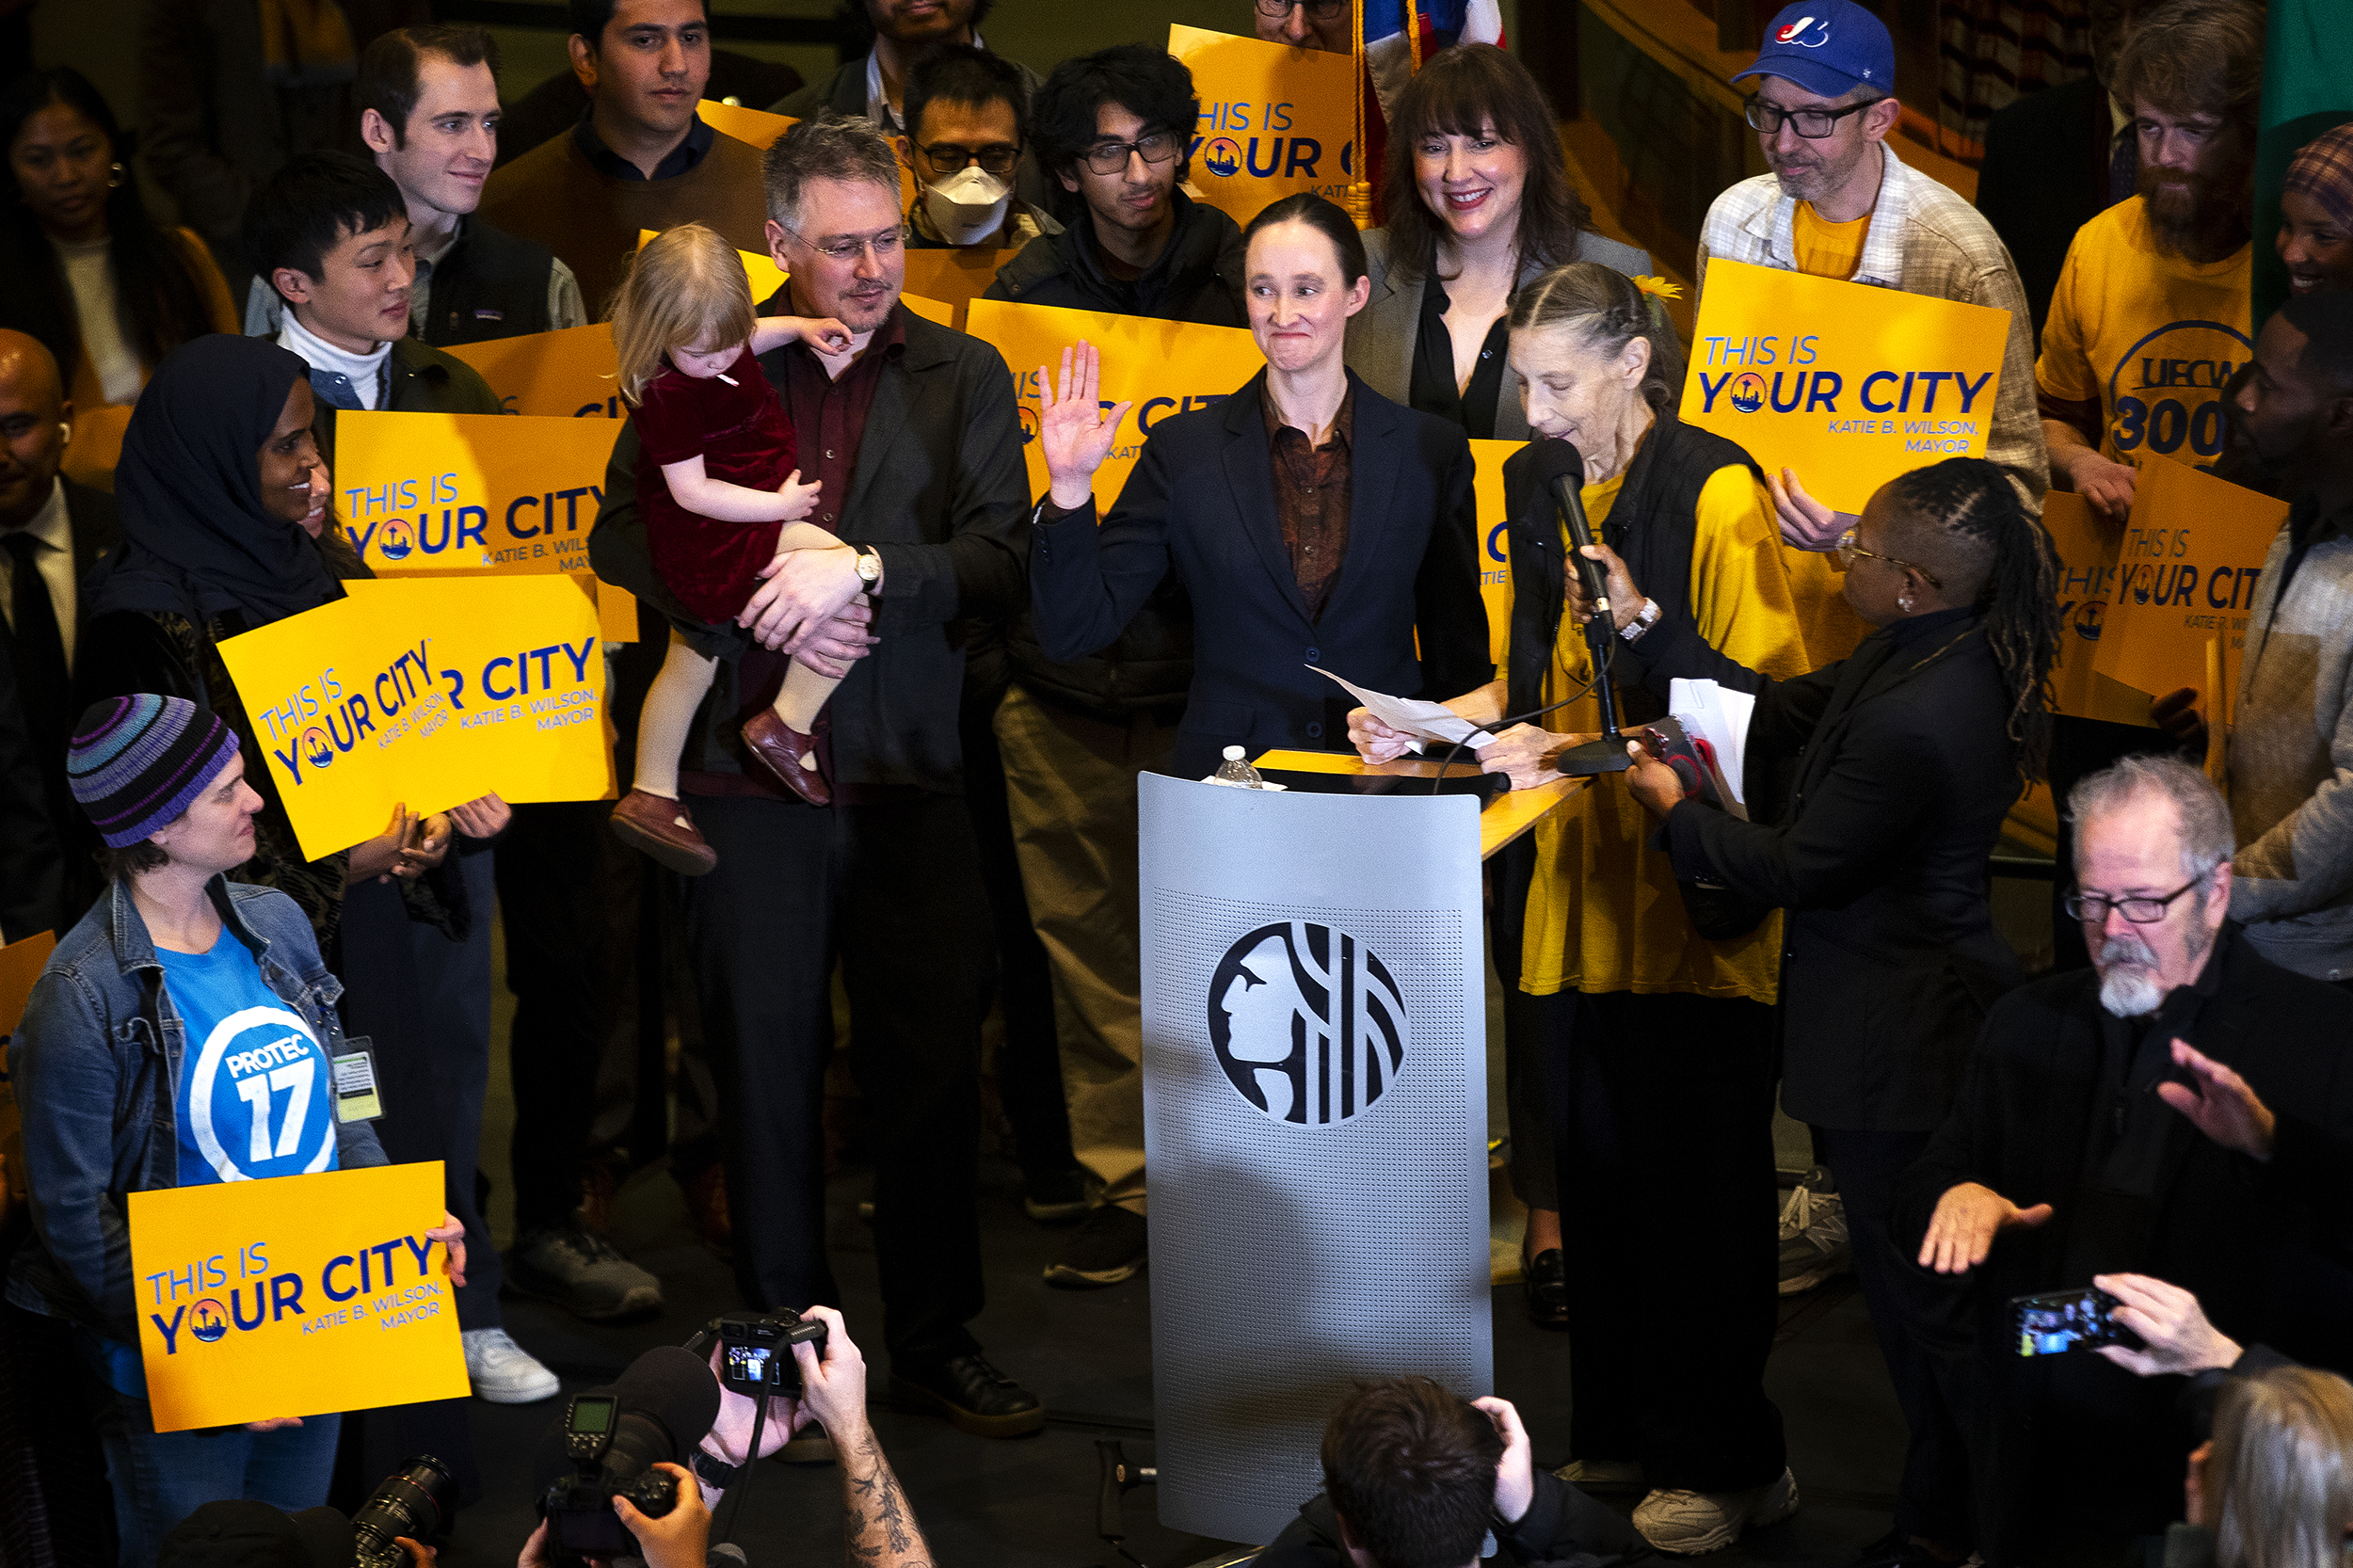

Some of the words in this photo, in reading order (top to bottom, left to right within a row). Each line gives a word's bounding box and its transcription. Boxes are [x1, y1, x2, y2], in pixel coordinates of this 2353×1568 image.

[1263, 103, 1293, 131] IS
[1705, 336, 1779, 366] THIS
[1788, 335, 1819, 366] IS
[1698, 371, 1843, 414] YOUR
[1860, 370, 1993, 414] CITY
[1828, 420, 1877, 434] KATIE
[1881, 420, 1897, 434] B.
[1904, 420, 1978, 437] WILSON,
[1904, 440, 1969, 454] MAYOR
[345, 479, 418, 519] THIS
[431, 472, 458, 504] IS
[345, 504, 488, 562] YOUR
[482, 546, 527, 567] KATIE
[552, 536, 589, 554] WIL
[2127, 529, 2168, 557] THIS
[2169, 529, 2190, 557] IS
[1481, 569, 1506, 585] TIE
[2119, 563, 2198, 607] YOUR
[482, 636, 595, 701] CITY
[259, 684, 319, 741] THIS
[318, 667, 343, 704] IS
[273, 693, 376, 786] YOUR
[375, 639, 432, 717] CITY
[460, 707, 505, 729] KATIE
[510, 704, 525, 720] B.
[536, 707, 595, 732] MAYOR
[225, 1034, 311, 1080] PROTEC
[236, 1057, 314, 1162] 17
[146, 1255, 228, 1305] THIS
[240, 1241, 270, 1279] IS
[151, 1272, 305, 1355] YOUR
[321, 1235, 437, 1303] CITY
[301, 1308, 348, 1336] KATIE
[352, 1304, 369, 1320] B.
[380, 1302, 440, 1332] MAYOR
